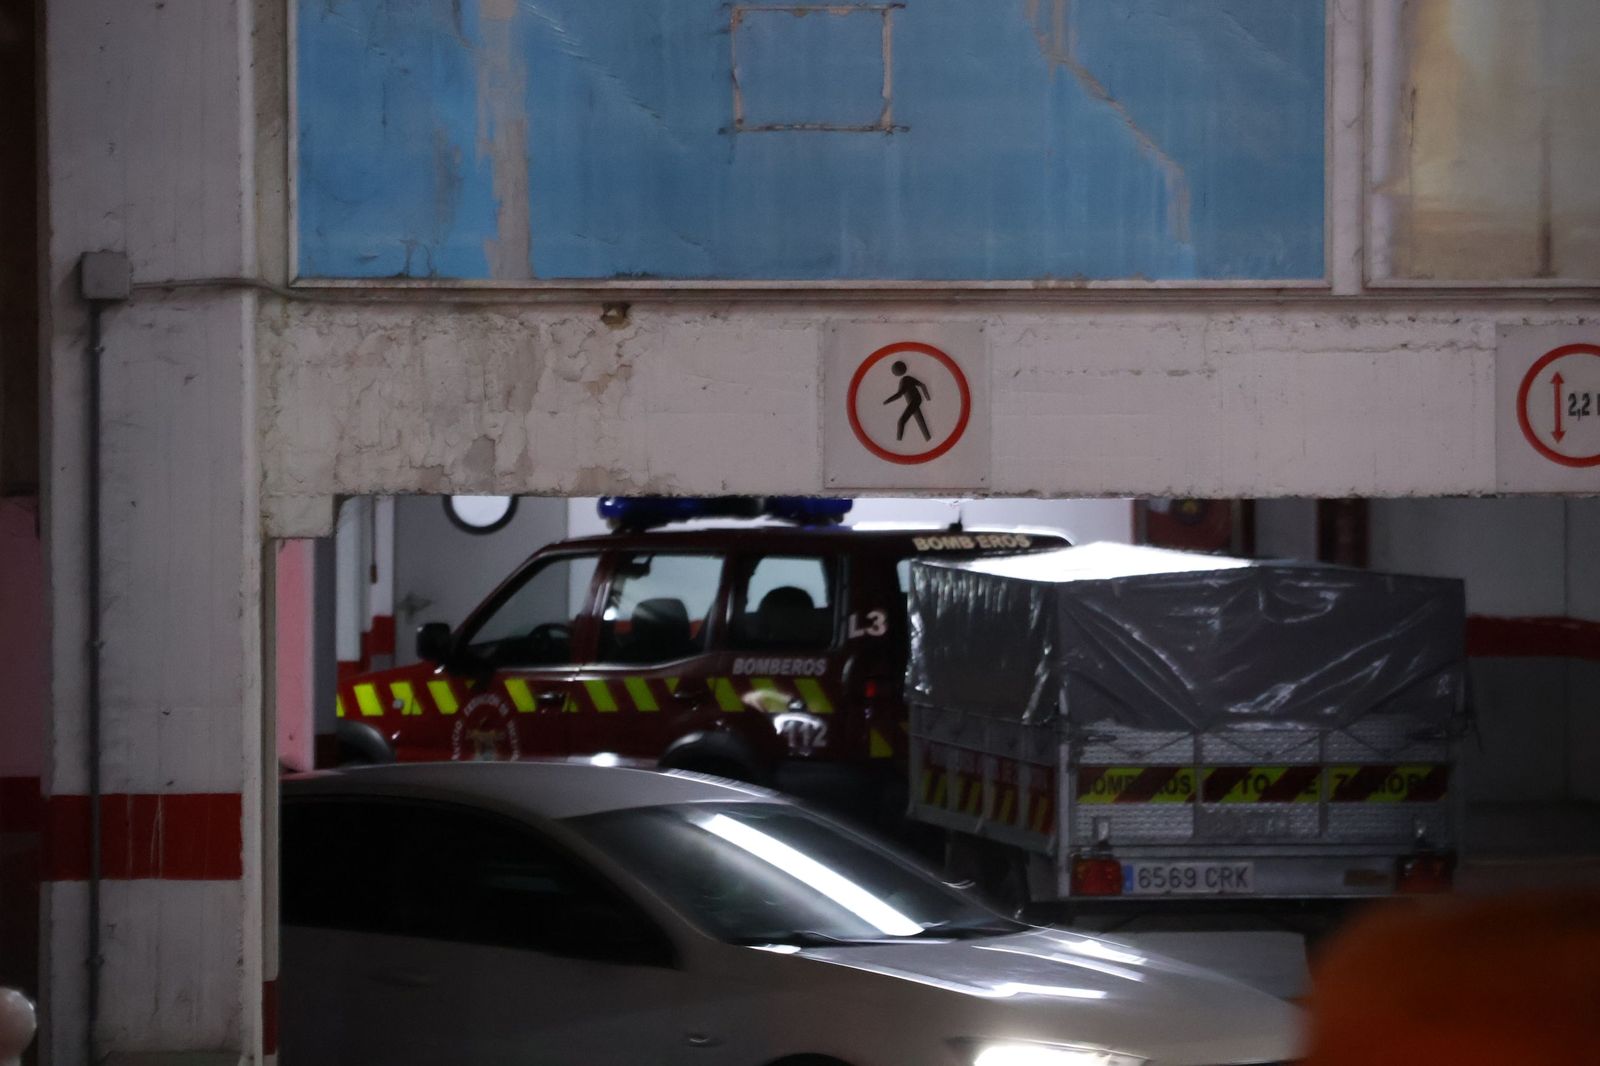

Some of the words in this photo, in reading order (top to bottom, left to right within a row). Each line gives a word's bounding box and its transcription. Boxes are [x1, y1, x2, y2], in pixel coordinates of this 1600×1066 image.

[1567, 392, 1591, 421] 2,2
[849, 611, 887, 638] L3
[732, 658, 827, 675] BOMBEROS
[1138, 867, 1197, 888] 6569
[1205, 866, 1248, 888] CRK
